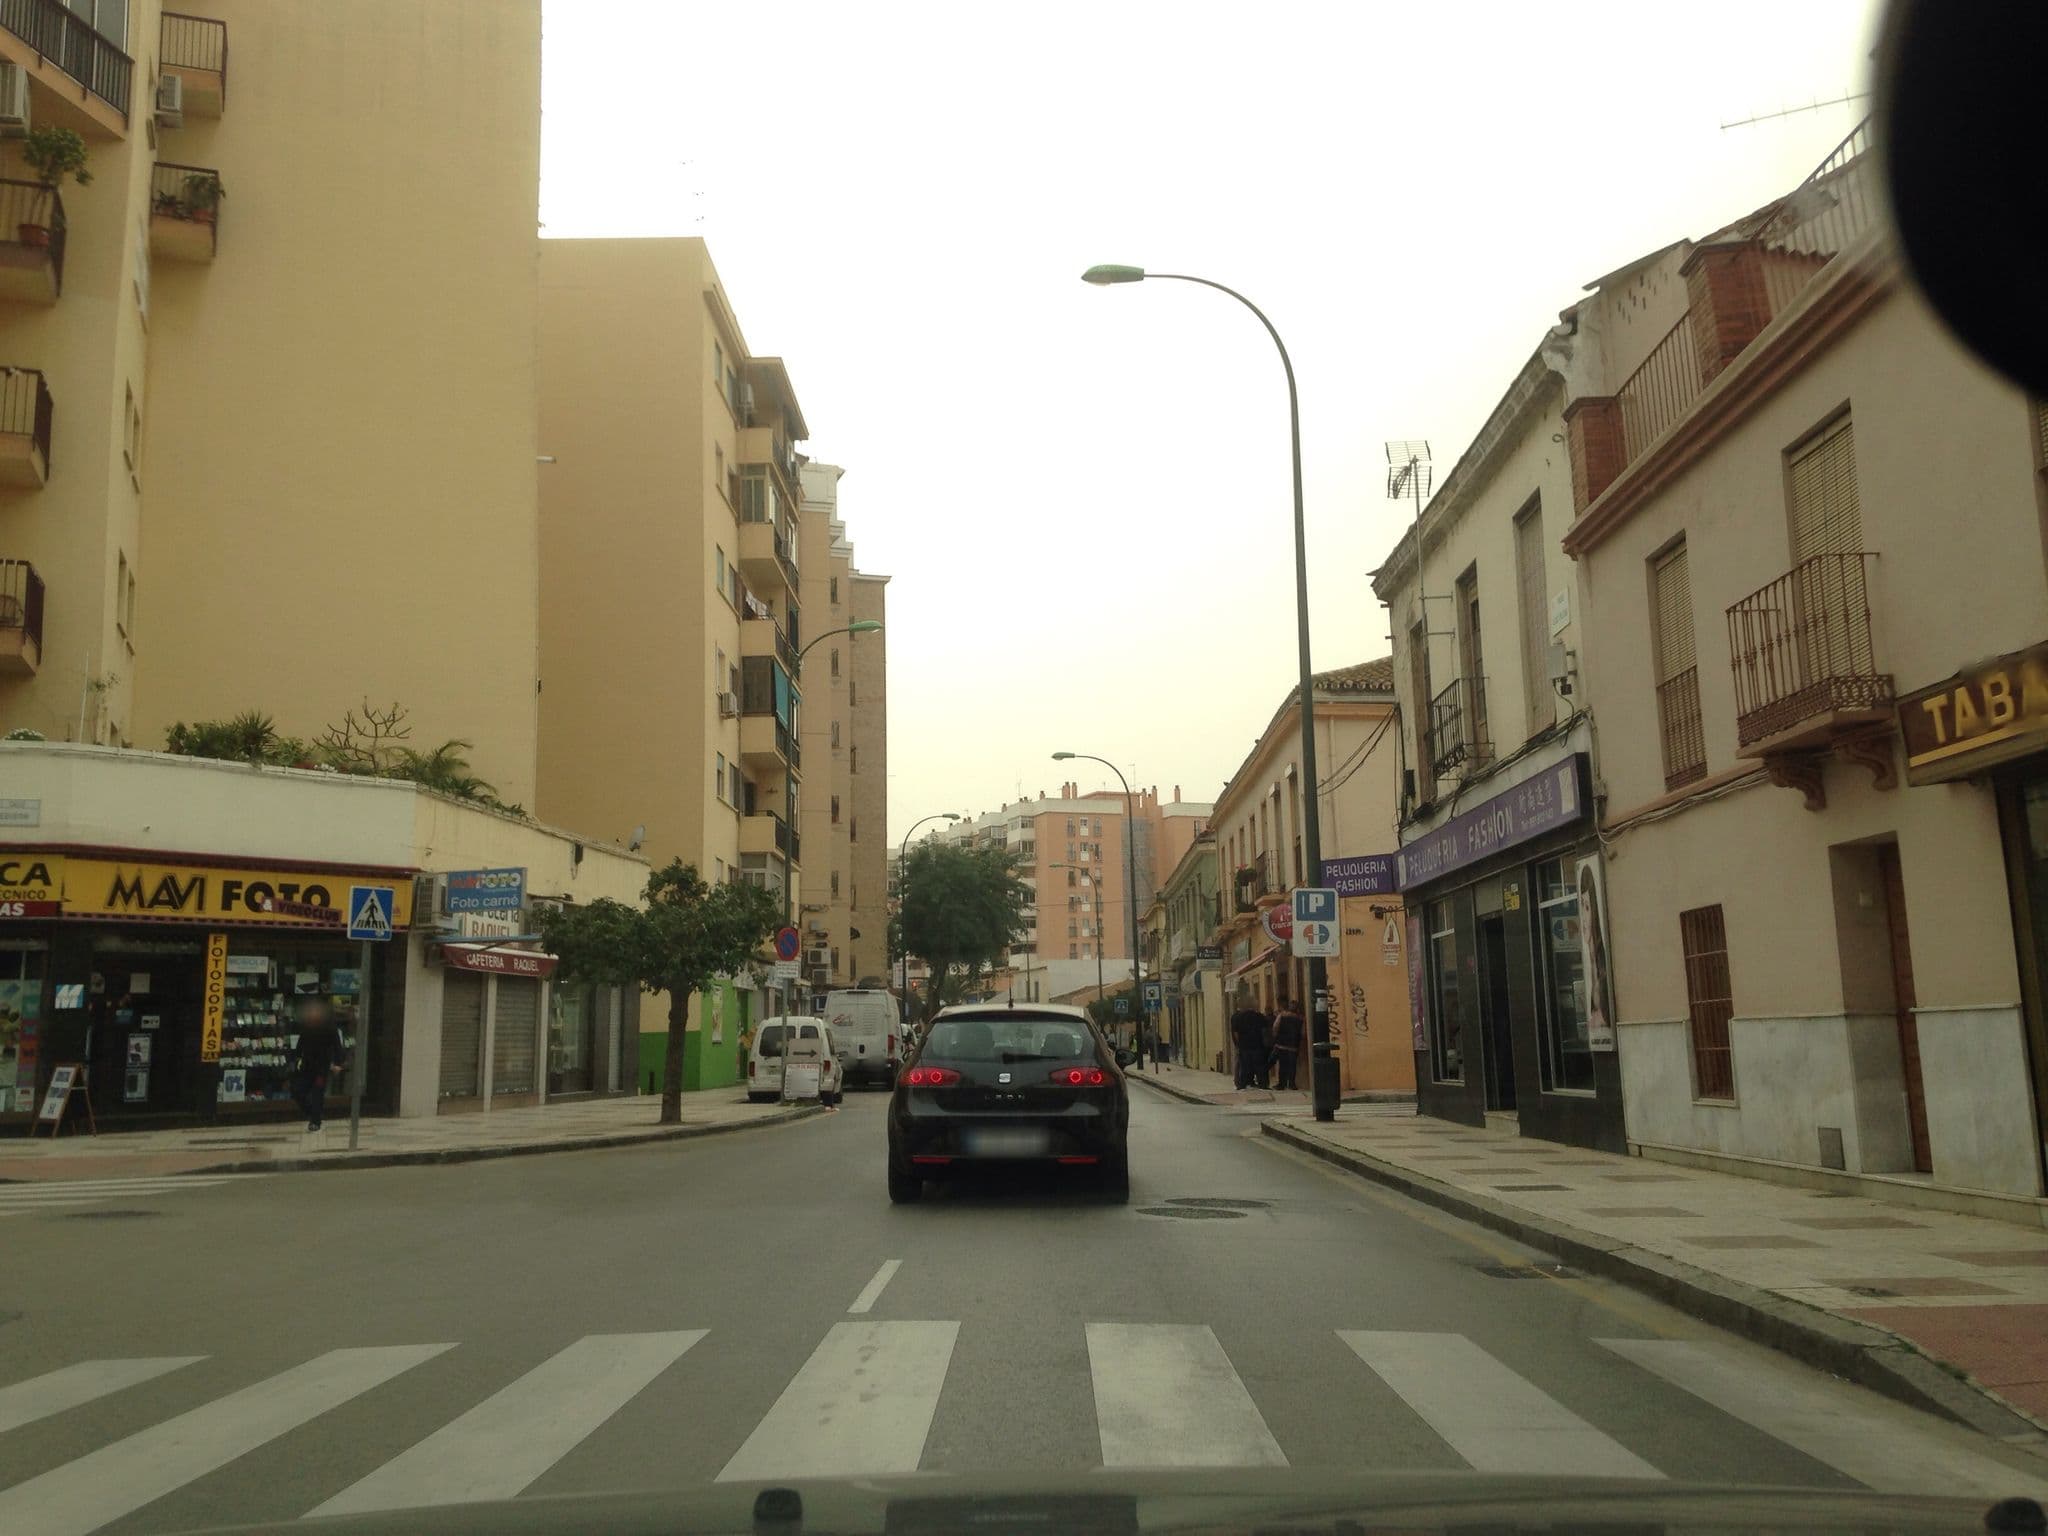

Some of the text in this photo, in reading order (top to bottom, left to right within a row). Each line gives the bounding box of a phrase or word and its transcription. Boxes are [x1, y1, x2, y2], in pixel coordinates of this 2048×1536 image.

[1409, 835, 1458, 879] PELUQUERIA
[1468, 801, 1513, 852] FASHION
[1326, 860, 1387, 878] PELUQUERIA
[104, 868, 330, 913] MAVI FOTO
[1335, 877, 1378, 892] FASHION
[0, 889, 46, 900] CNICO
[450, 897, 479, 909] Foto
[1309, 893, 1324, 913] P
[466, 953, 540, 972] CAFETERIA RAQUEL
[206, 936, 224, 1050] FOTOCOPIAS
